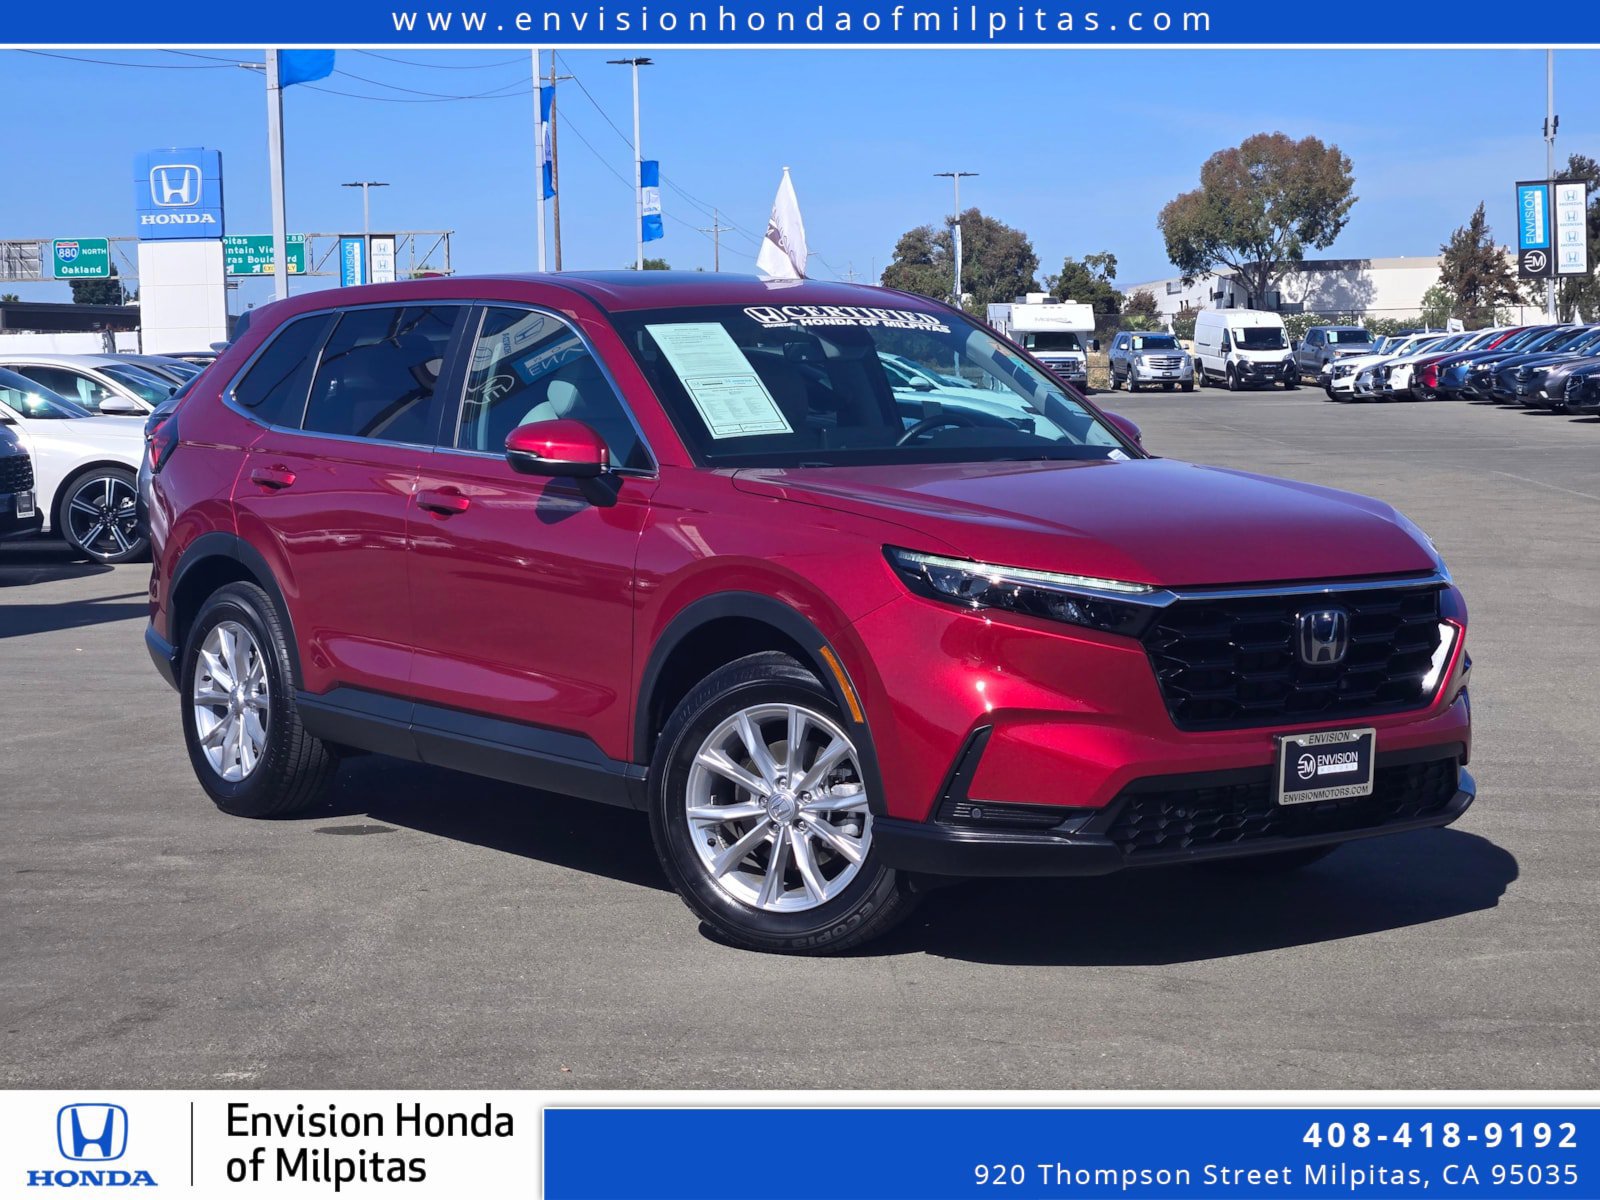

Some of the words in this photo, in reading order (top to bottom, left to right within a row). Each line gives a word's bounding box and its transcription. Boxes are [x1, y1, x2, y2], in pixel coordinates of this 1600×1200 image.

[141, 213, 216, 225] HONDA
[1524, 190, 1536, 244] ENVISION
[59, 248, 77, 258] 880
[247, 255, 297, 264] Boulerd
[61, 266, 102, 274] Oakland
[345, 242, 355, 286] ENVISION
[782, 305, 941, 325] CERTIFIED
[800, 318, 859, 327] HONDA
[859, 319, 878, 327] OF
[884, 320, 951, 333] MILPITAS
[1308, 732, 1351, 745] ENVISION
[1317, 751, 1359, 766] ENVISION
[1283, 785, 1369, 803] ENVISIONMOTORS.COM
